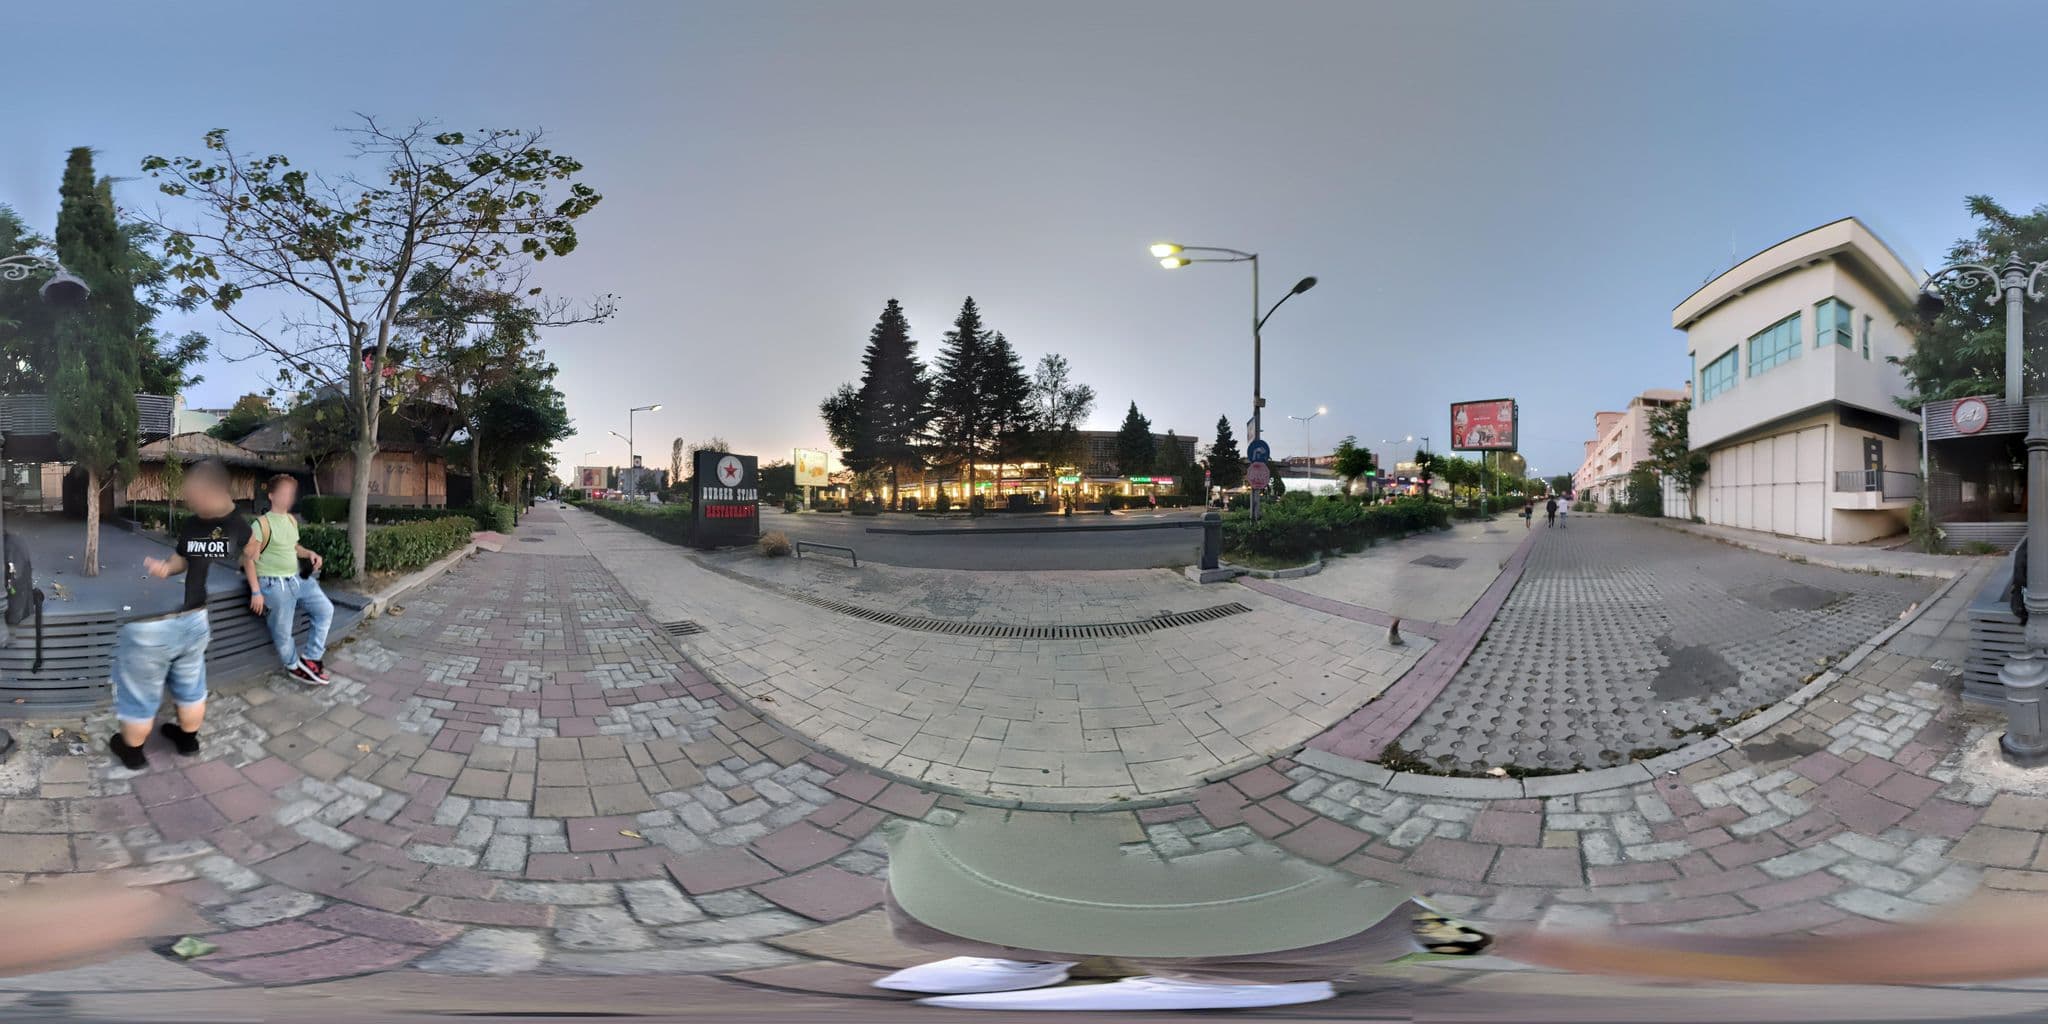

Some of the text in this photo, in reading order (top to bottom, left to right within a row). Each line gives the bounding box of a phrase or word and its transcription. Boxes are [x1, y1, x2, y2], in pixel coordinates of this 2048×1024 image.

[703, 486, 734, 500] BURGER
[187, 541, 206, 552] WIN
[208, 542, 224, 552] OR
